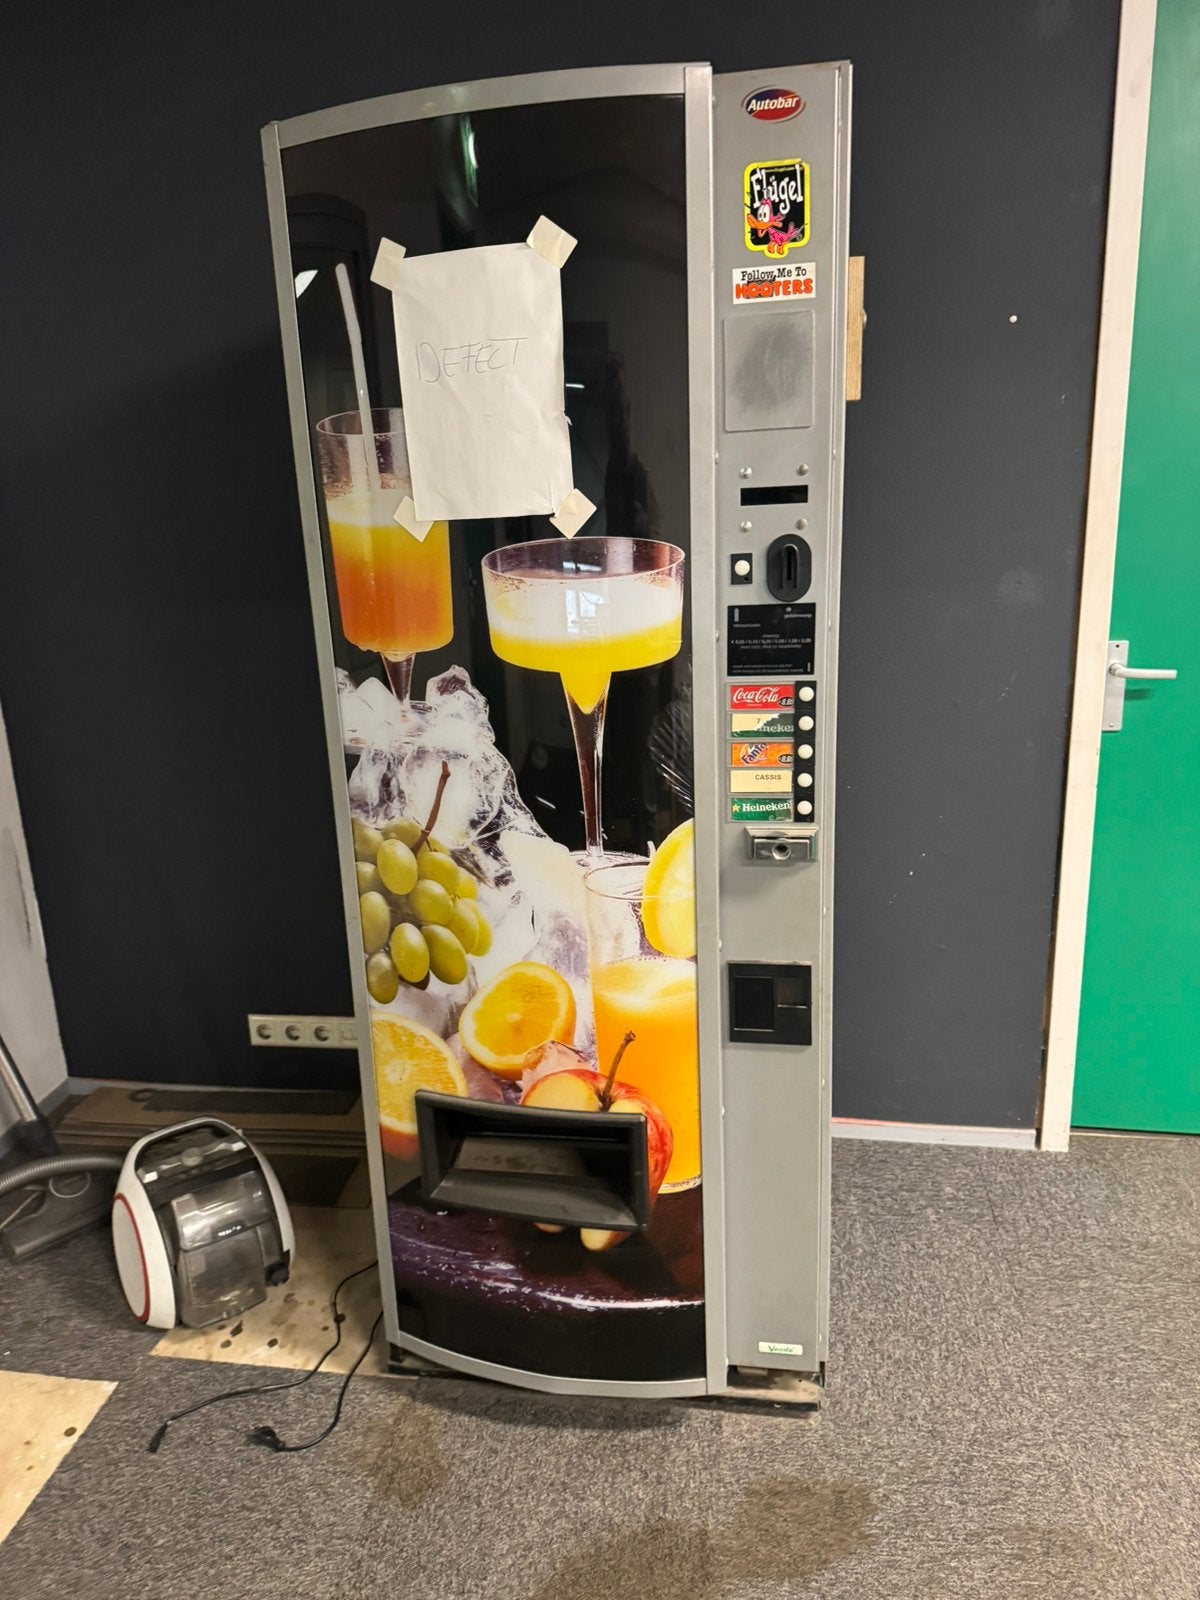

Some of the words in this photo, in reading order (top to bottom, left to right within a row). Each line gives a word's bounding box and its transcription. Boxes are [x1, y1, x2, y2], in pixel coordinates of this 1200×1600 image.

[747, 97, 799, 111] Autobar
[750, 164, 804, 215] Flügel
[741, 270, 775, 281] Follow
[777, 267, 793, 278] Me
[795, 266, 808, 277] To
[735, 278, 814, 299] HOOTERS
[416, 337, 529, 384] DEFECT
[733, 686, 780, 704] Coca-Cola
[742, 802, 791, 812] Heineken
